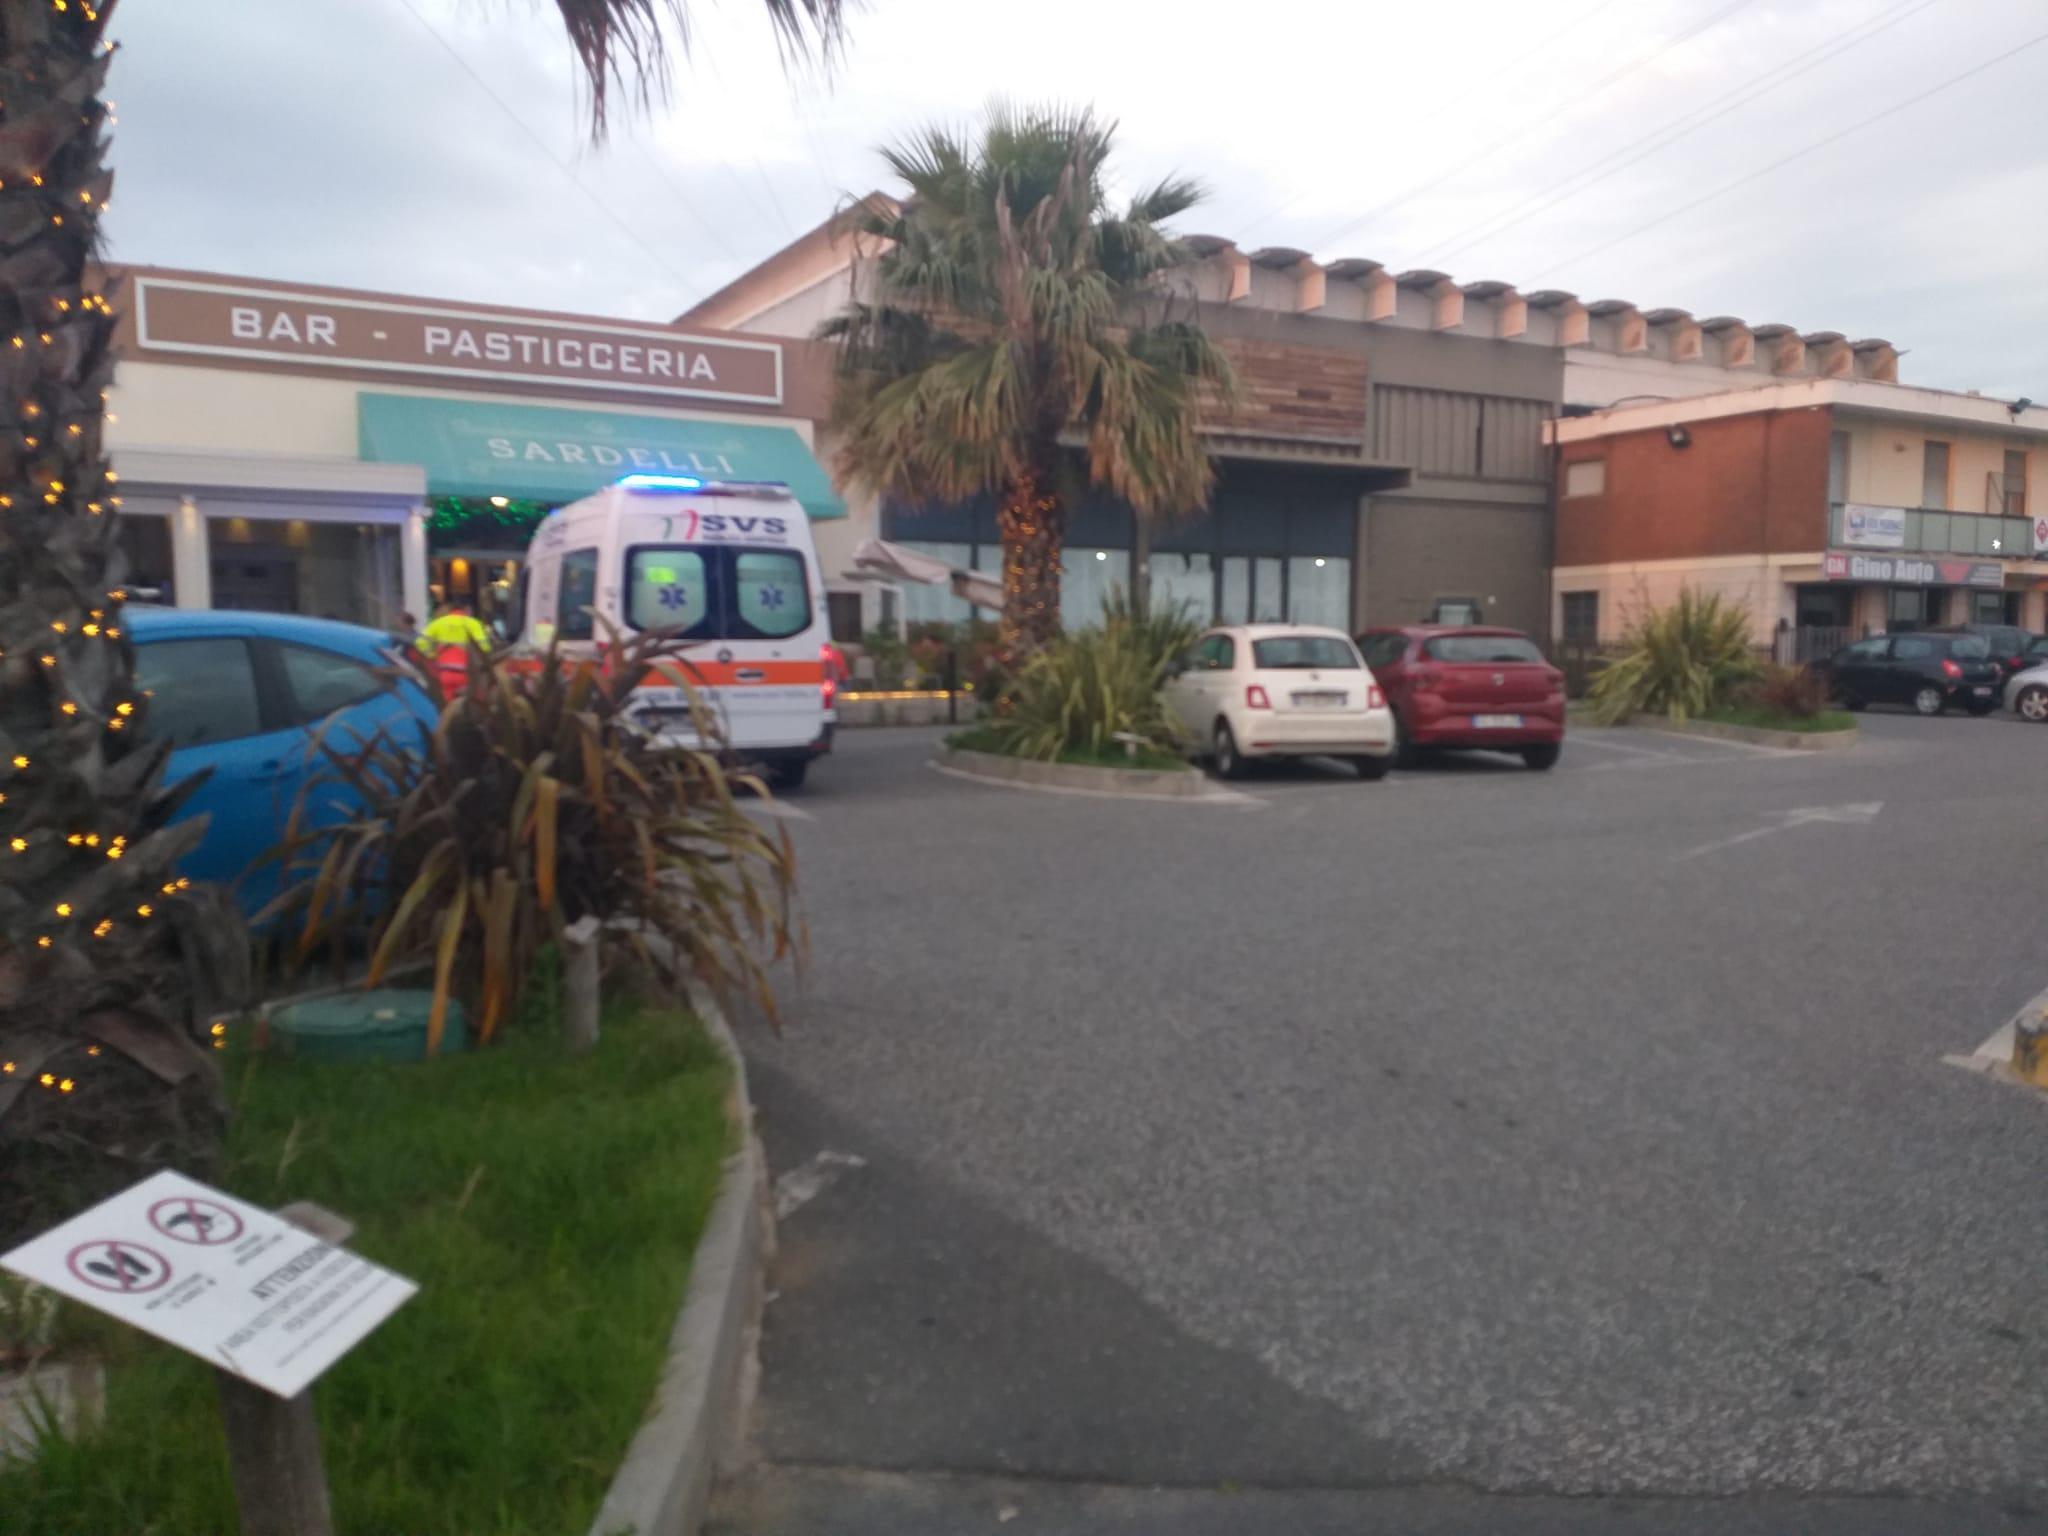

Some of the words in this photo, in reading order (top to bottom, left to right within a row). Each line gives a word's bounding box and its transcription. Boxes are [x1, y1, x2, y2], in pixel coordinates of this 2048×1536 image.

[231, 307, 337, 346] BAR
[424, 325, 716, 380] PASTICCERIA
[487, 437, 735, 474] SARDELLI
[702, 515, 786, 533] SVS
